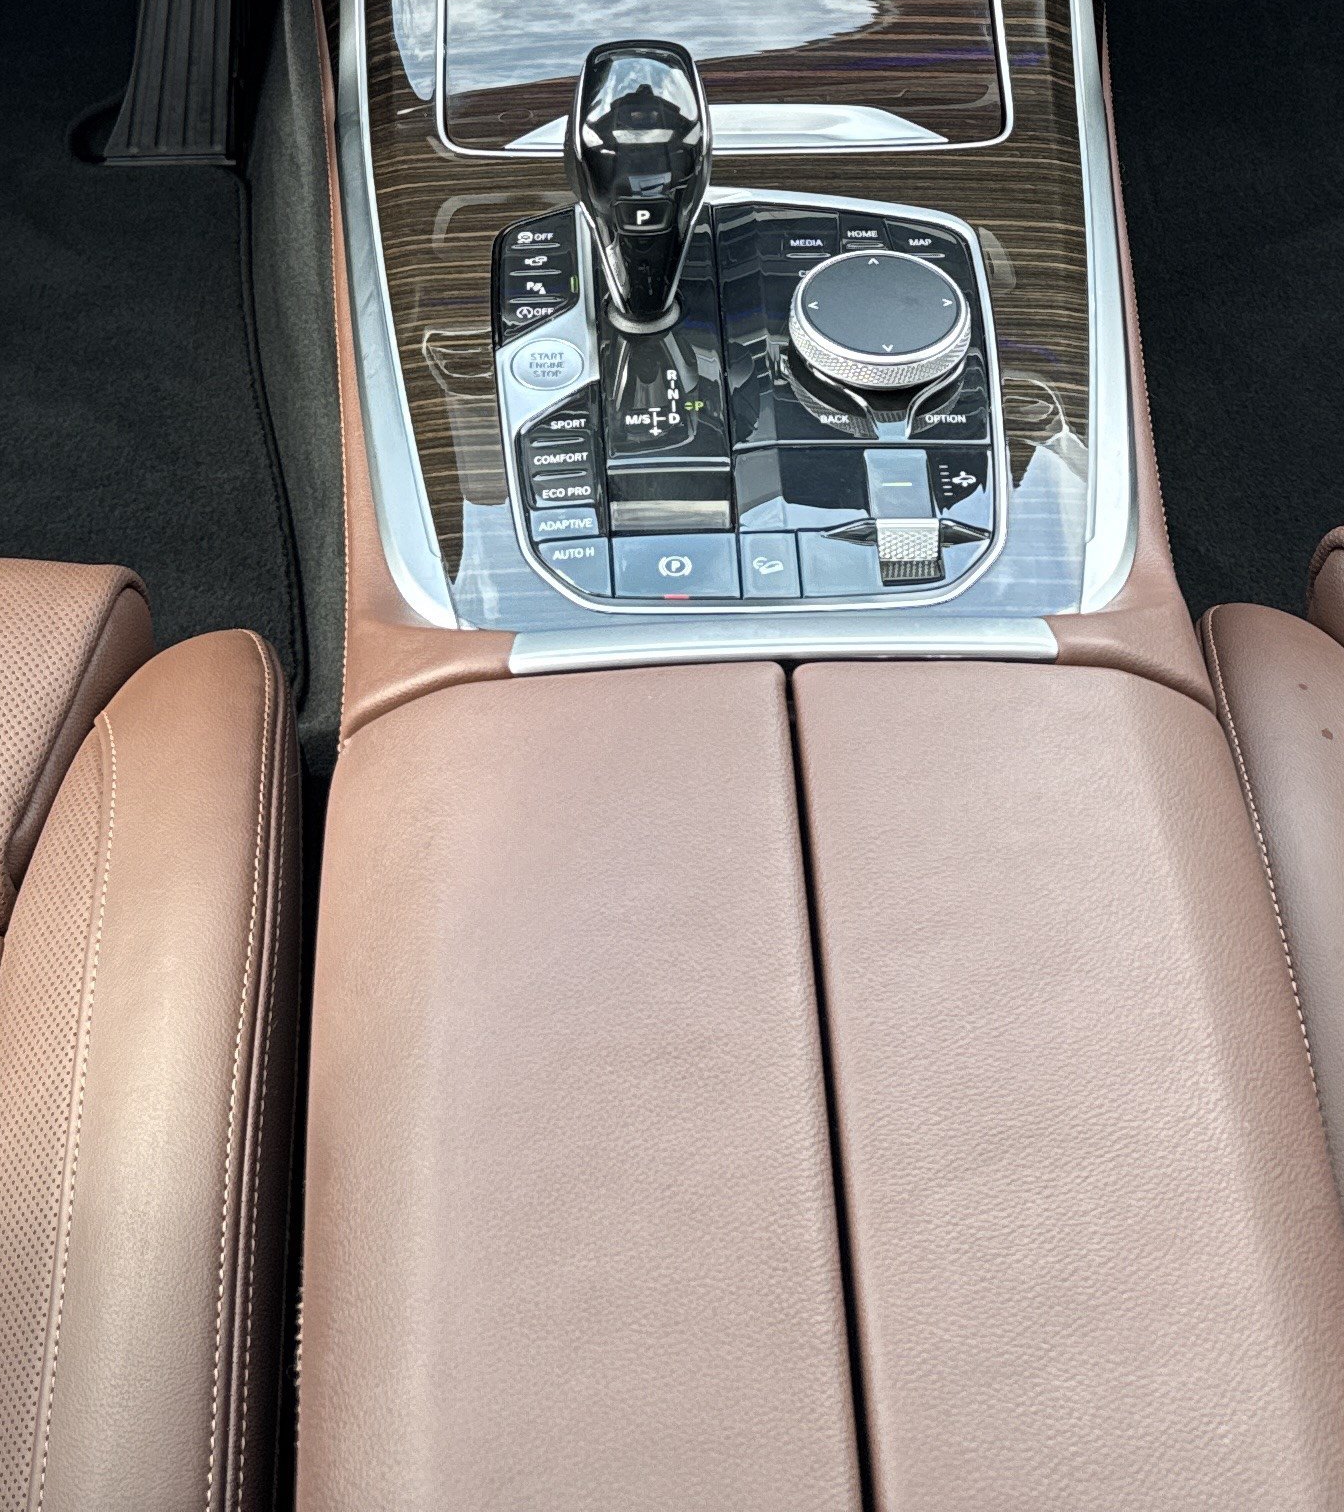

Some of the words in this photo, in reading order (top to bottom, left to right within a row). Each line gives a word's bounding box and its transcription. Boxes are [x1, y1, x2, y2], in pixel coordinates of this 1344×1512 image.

[636, 210, 651, 225] P
[534, 232, 554, 241] OFF
[846, 230, 878, 238] HOME
[790, 239, 823, 247] MEDIA
[534, 308, 554, 316] OFF
[530, 352, 564, 361] START
[529, 361, 564, 369] ENGINE
[533, 370, 562, 378] STOP
[666, 369, 677, 380] R
[667, 388, 679, 400] N
[694, 400, 704, 411] P
[550, 418, 586, 430] SPORT
[625, 414, 651, 425] M/S
[668, 413, 680, 424] D
[820, 414, 850, 424] BACK
[925, 414, 966, 423] OPTION
[533, 452, 588, 465] COMFORT
[542, 489, 565, 499] ECO
[568, 486, 591, 496] PRO
[539, 518, 593, 531] ADAPTIVE
[553, 548, 583, 560] AUTO
[585, 547, 595, 557] H
